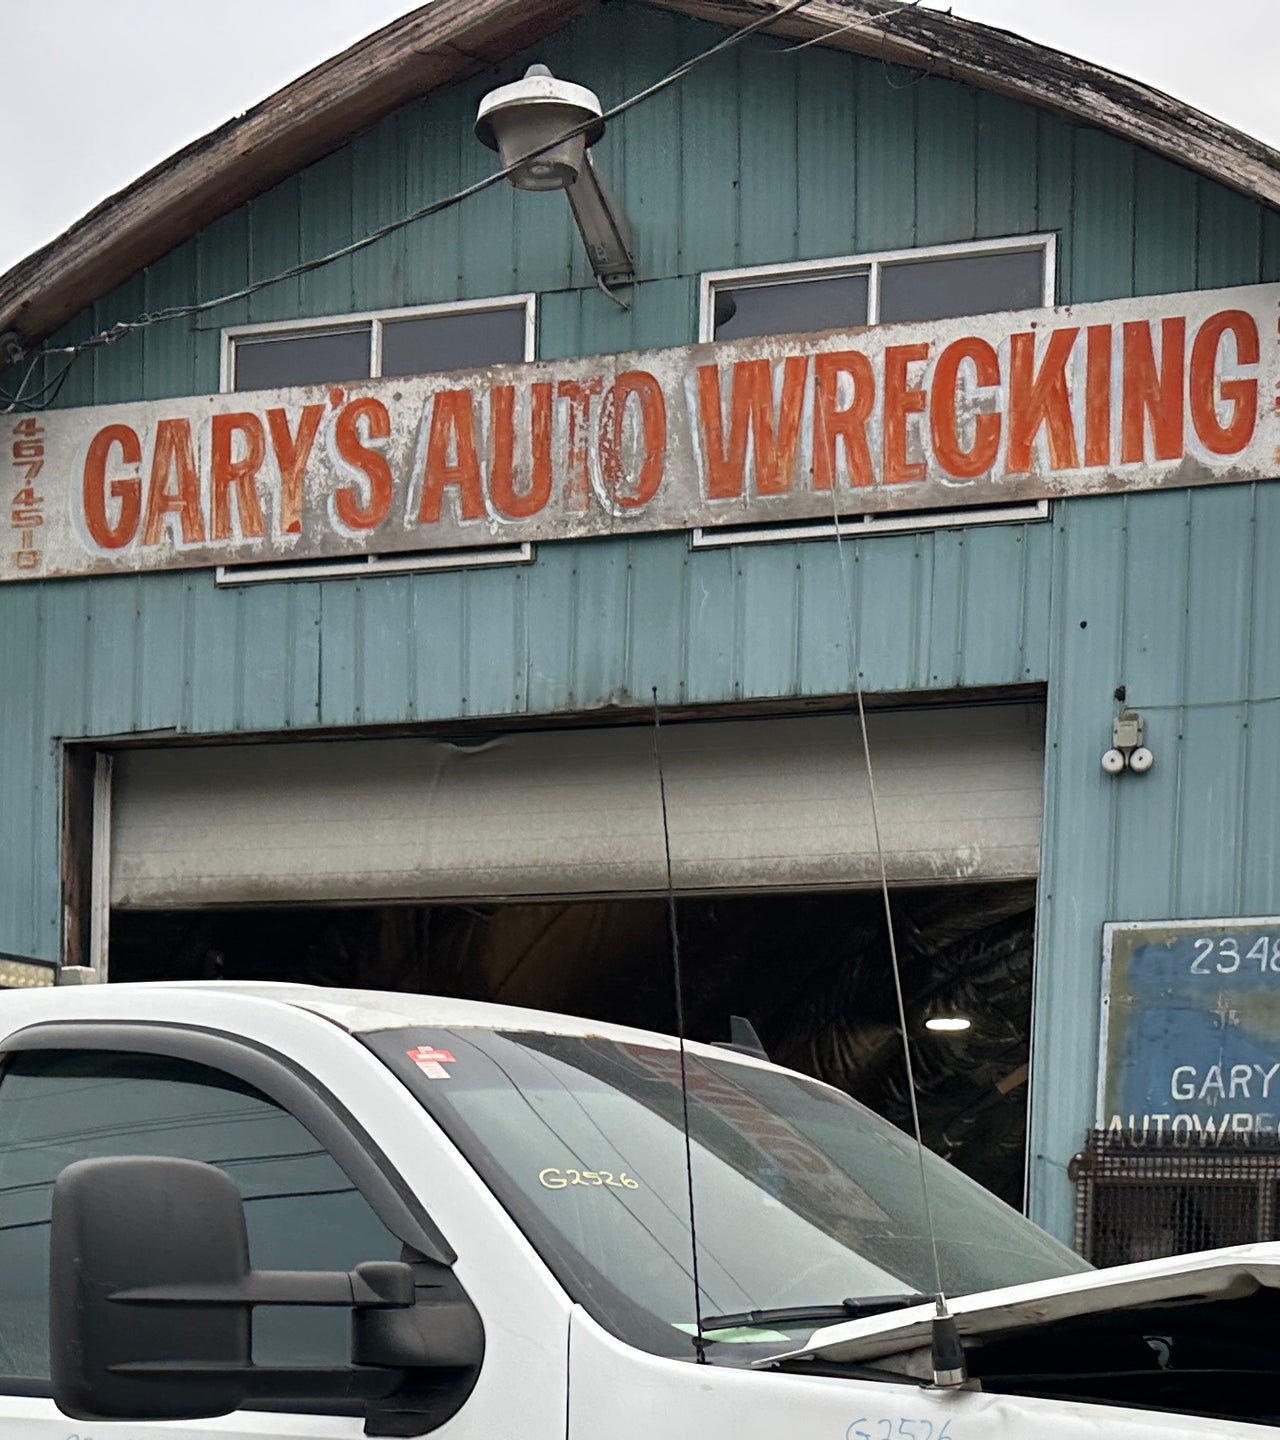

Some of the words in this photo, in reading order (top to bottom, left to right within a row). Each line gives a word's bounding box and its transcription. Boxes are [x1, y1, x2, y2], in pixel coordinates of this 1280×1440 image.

[82, 386, 393, 550] GARY'S
[417, 369, 667, 524] AUTO
[696, 308, 1261, 500] WRECKING
[538, 1167, 639, 1190] G2526
